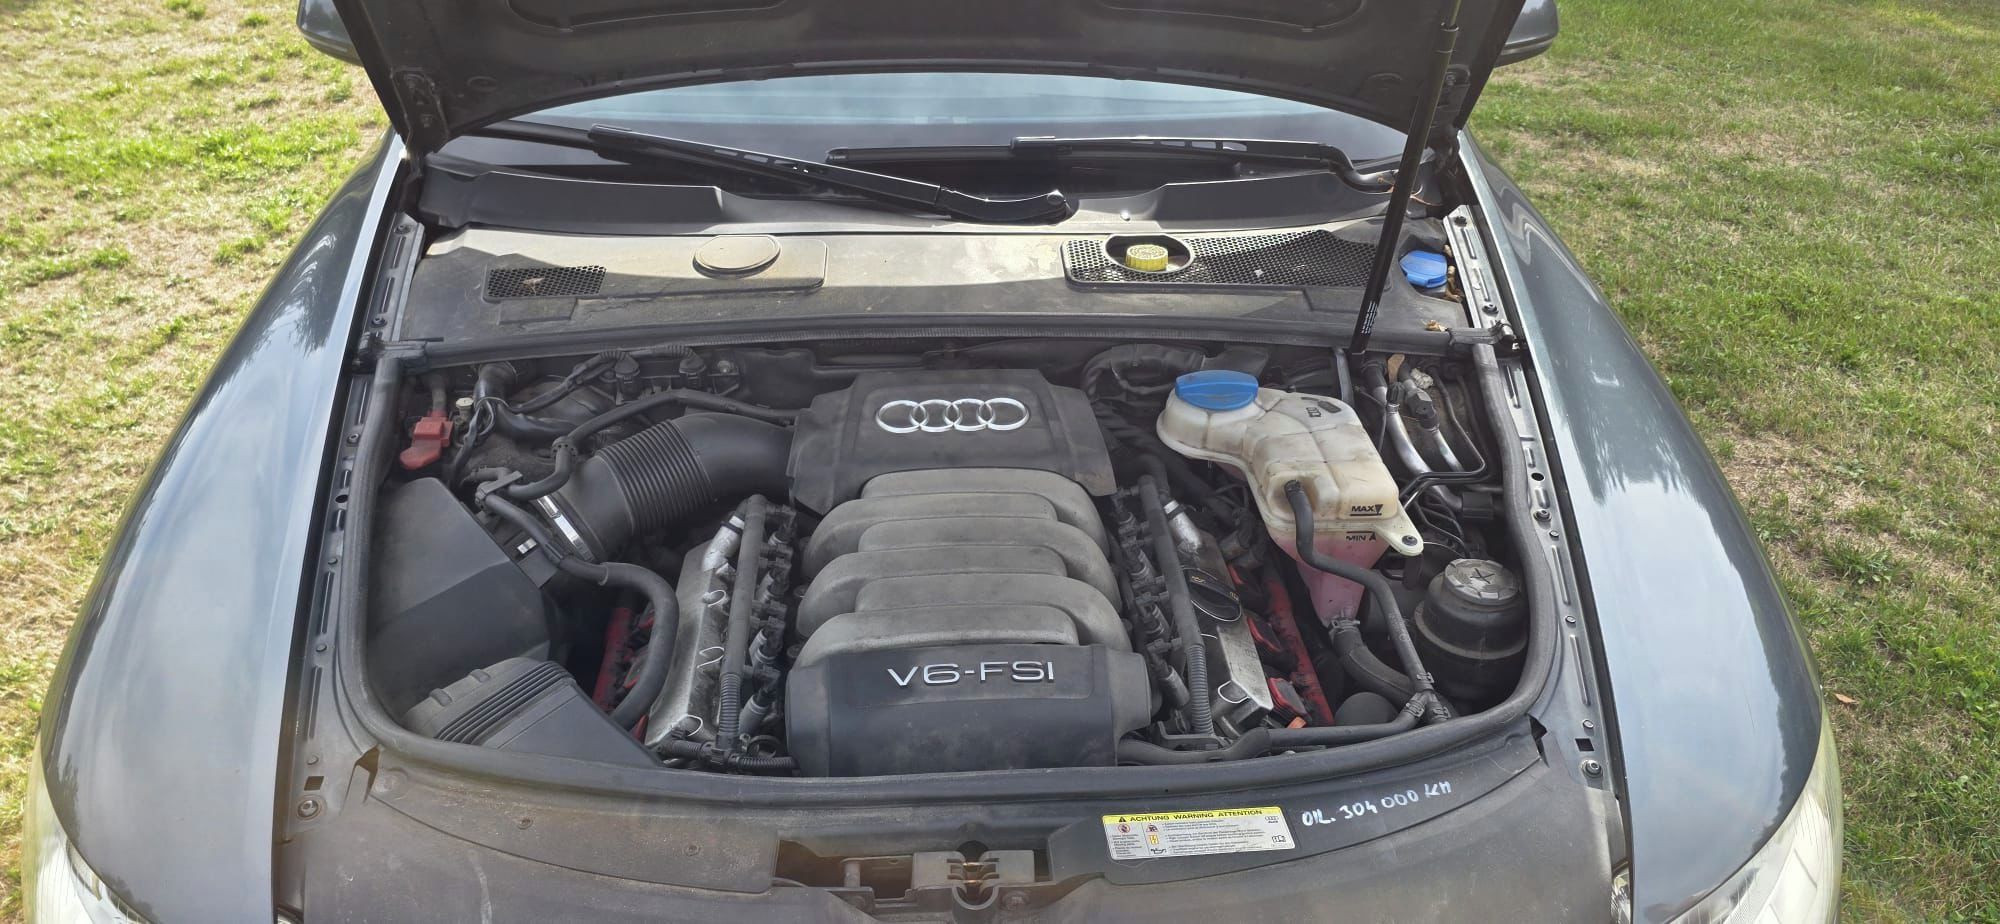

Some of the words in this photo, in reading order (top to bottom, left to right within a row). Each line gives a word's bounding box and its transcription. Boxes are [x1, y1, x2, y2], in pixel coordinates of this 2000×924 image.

[887, 661, 1054, 687] V6-FSI
[1130, 814, 1170, 822] ACHTUNG
[1173, 812, 1214, 820] WARNING
[1218, 809, 1262, 817] ATTENTION
[1340, 800, 1378, 819] 304
[1381, 789, 1419, 809] 000
